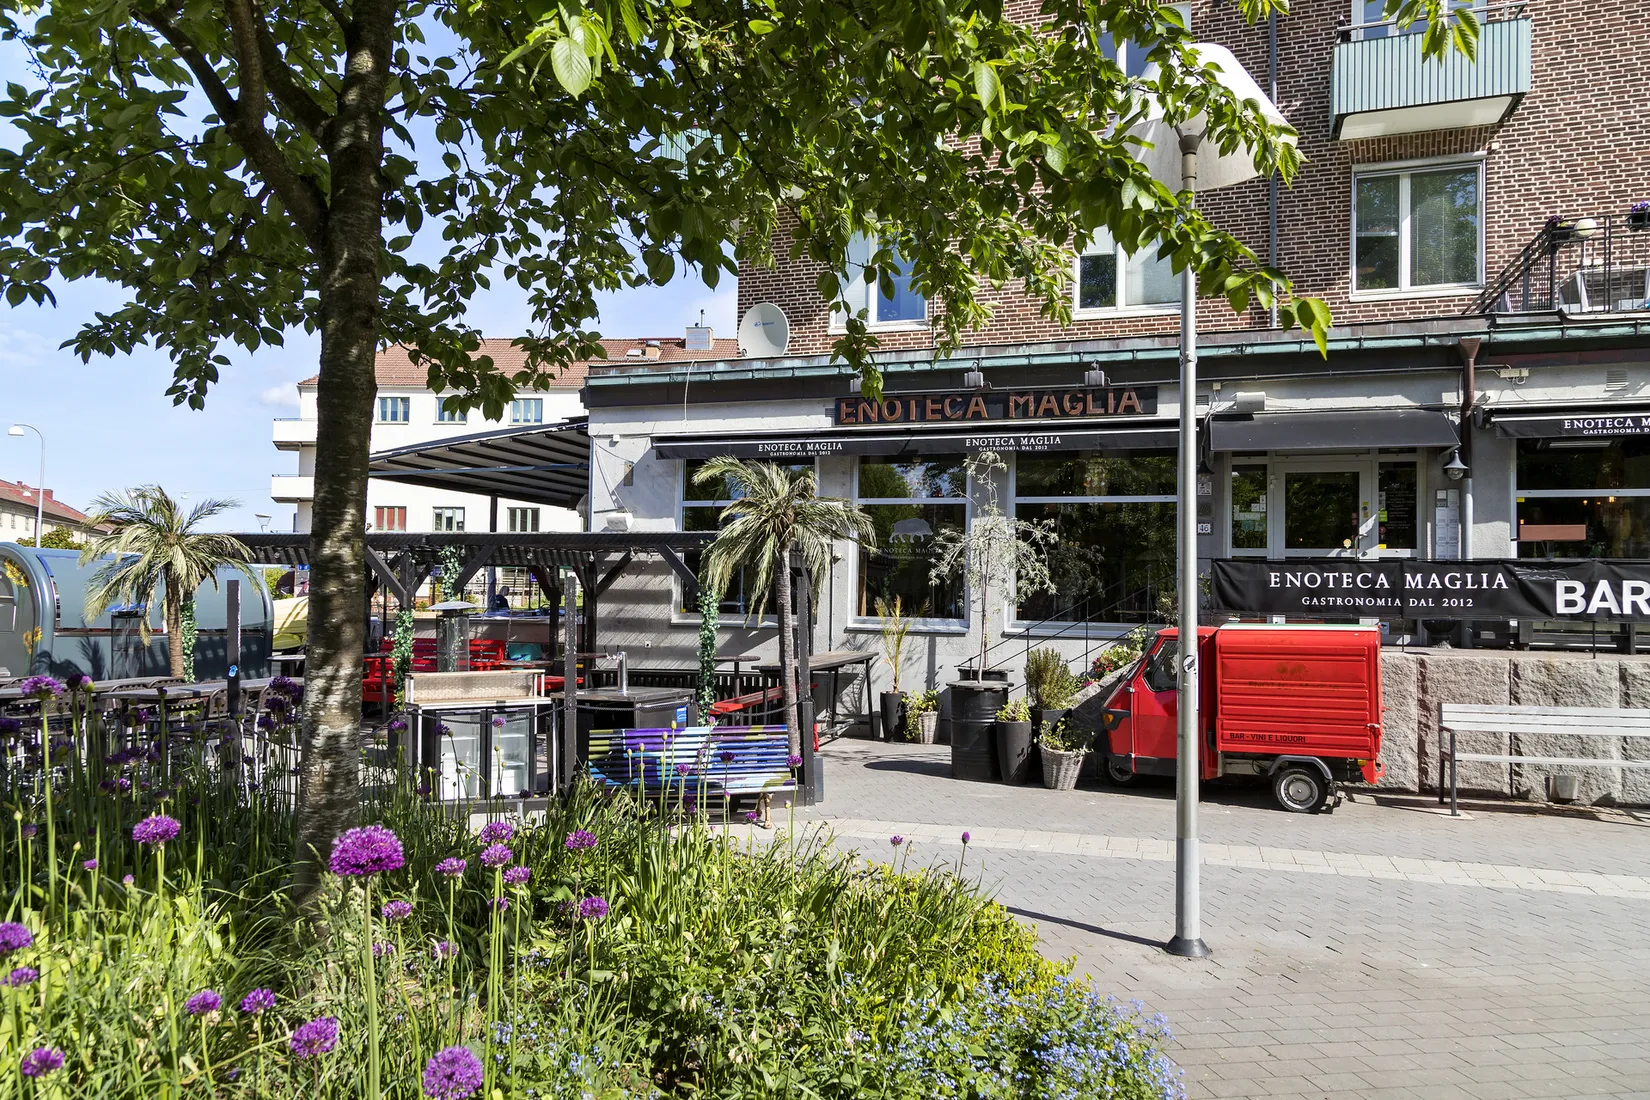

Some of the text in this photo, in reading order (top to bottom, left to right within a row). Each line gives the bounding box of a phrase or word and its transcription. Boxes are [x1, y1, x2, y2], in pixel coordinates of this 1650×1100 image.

[840, 387, 1143, 424] ENOTECA MAGLIA
[1564, 418, 1634, 429] ENOTECA
[758, 442, 843, 452] ENOTECA MAGLIA
[965, 436, 1061, 447] ENOTECA MAGLIA
[1269, 572, 1509, 589] ENOTECA MAGLIA
[1301, 596, 1474, 607] GASTRONOMIA DAL 2012
[1556, 580, 1650, 614] BAR
[1275, 735, 1306, 743] LIQUORI
